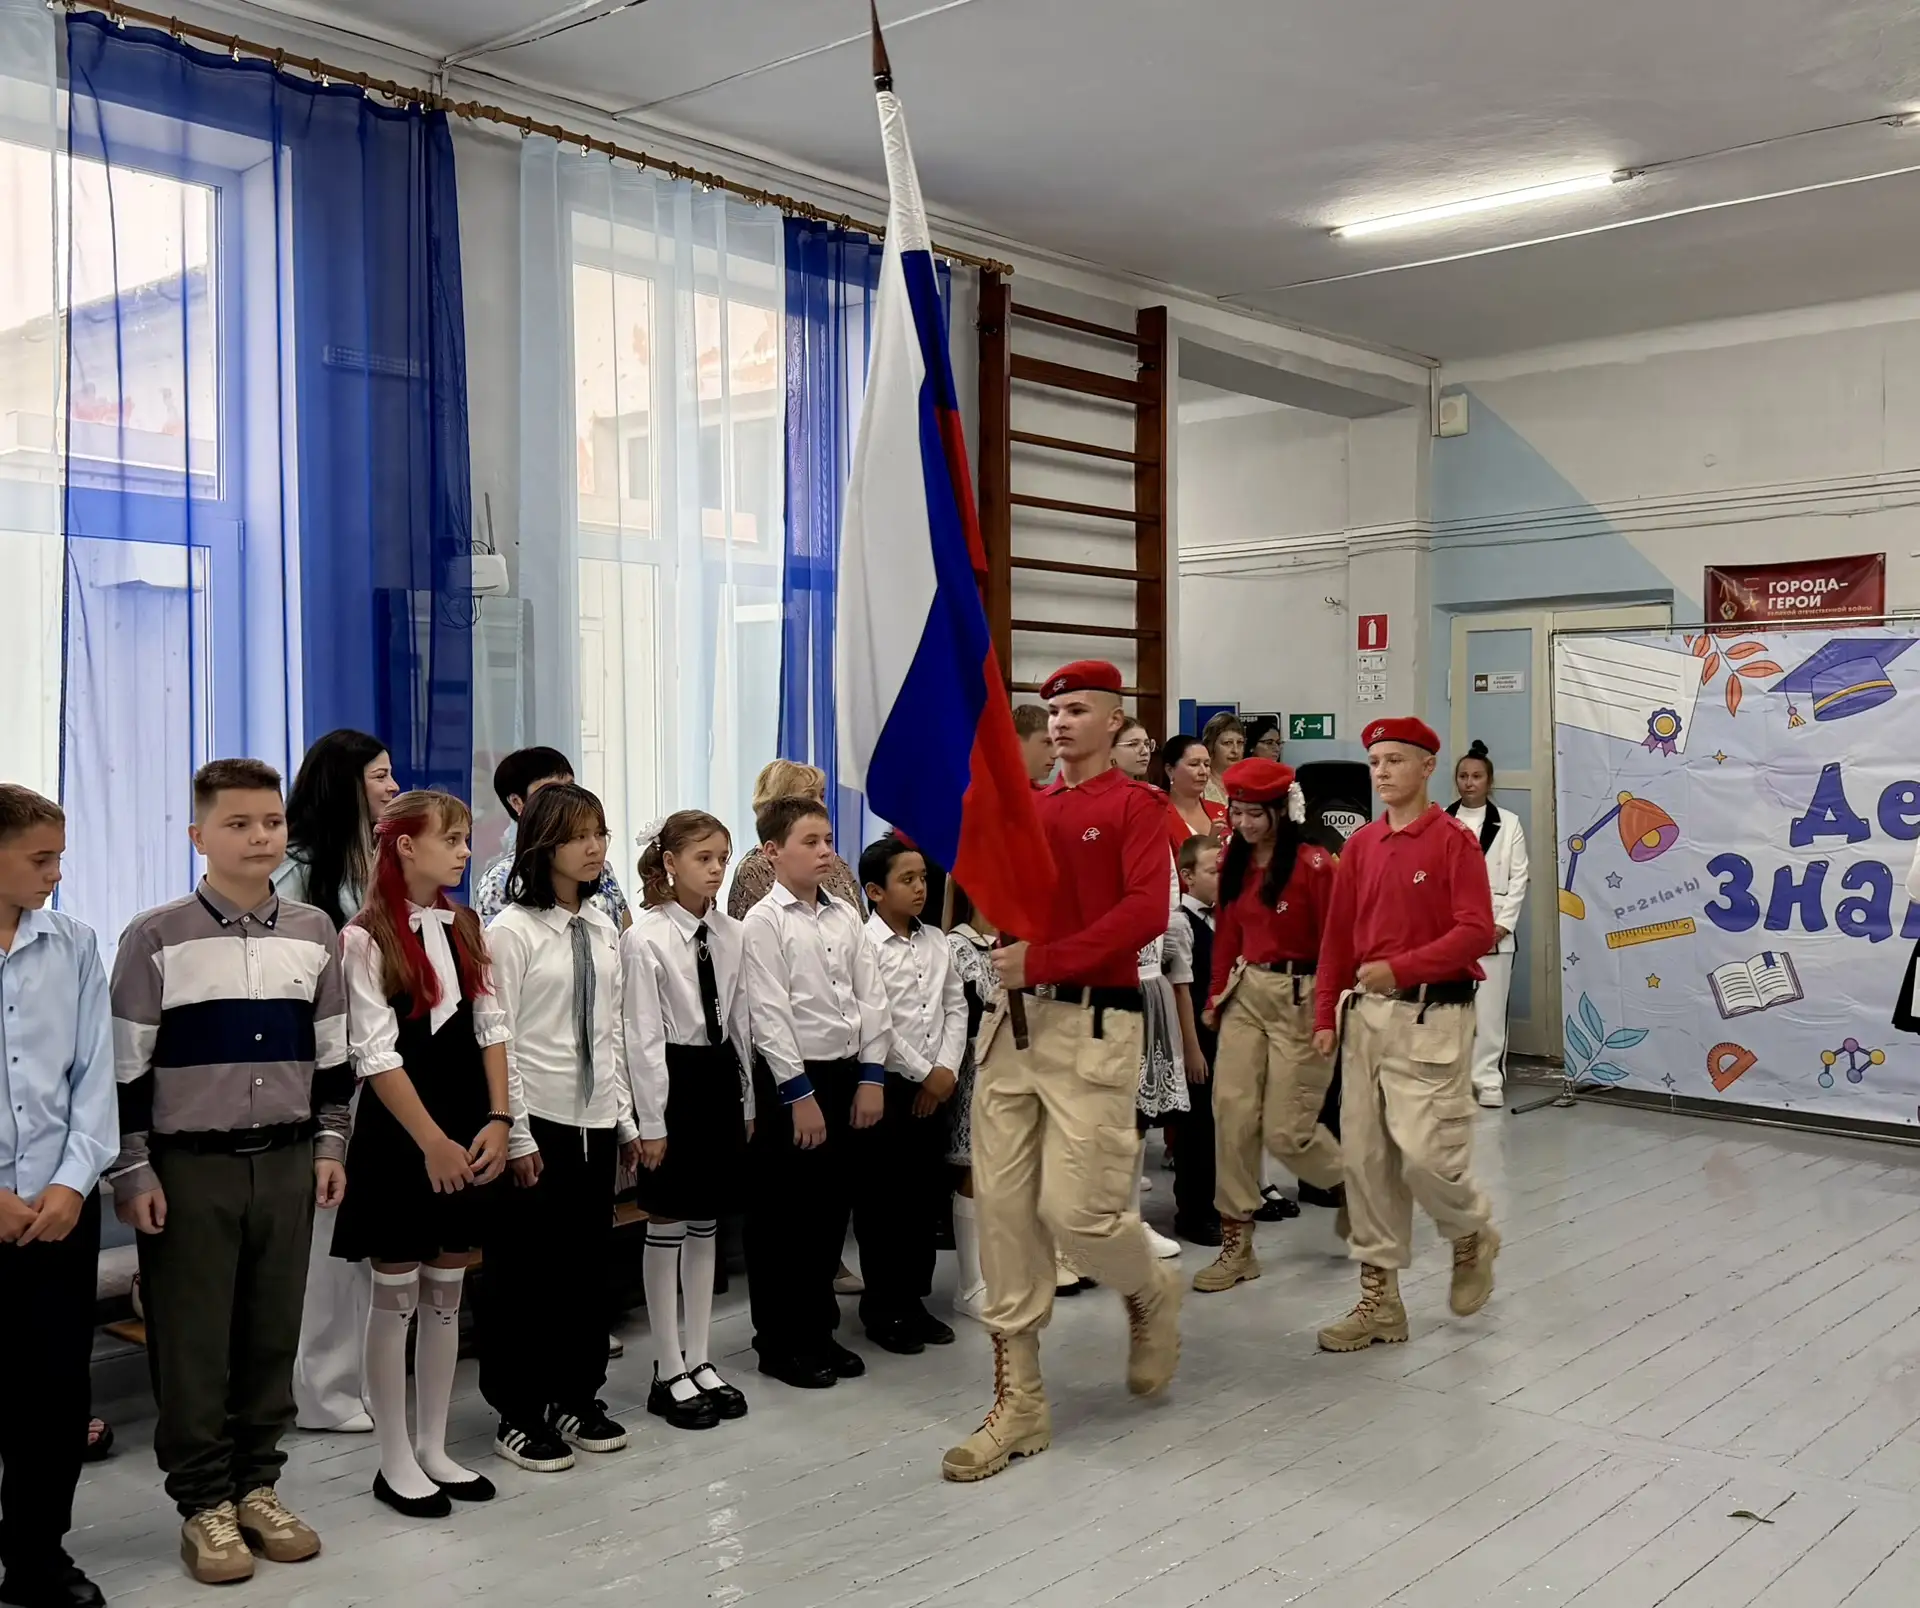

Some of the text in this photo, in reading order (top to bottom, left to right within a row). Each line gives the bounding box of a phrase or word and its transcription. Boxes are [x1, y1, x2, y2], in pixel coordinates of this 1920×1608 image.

[1768, 578, 1848, 594] ГОРОДА-
[1768, 595, 1821, 609] ГЕРОИ
[1323, 814, 1356, 825] 1000
